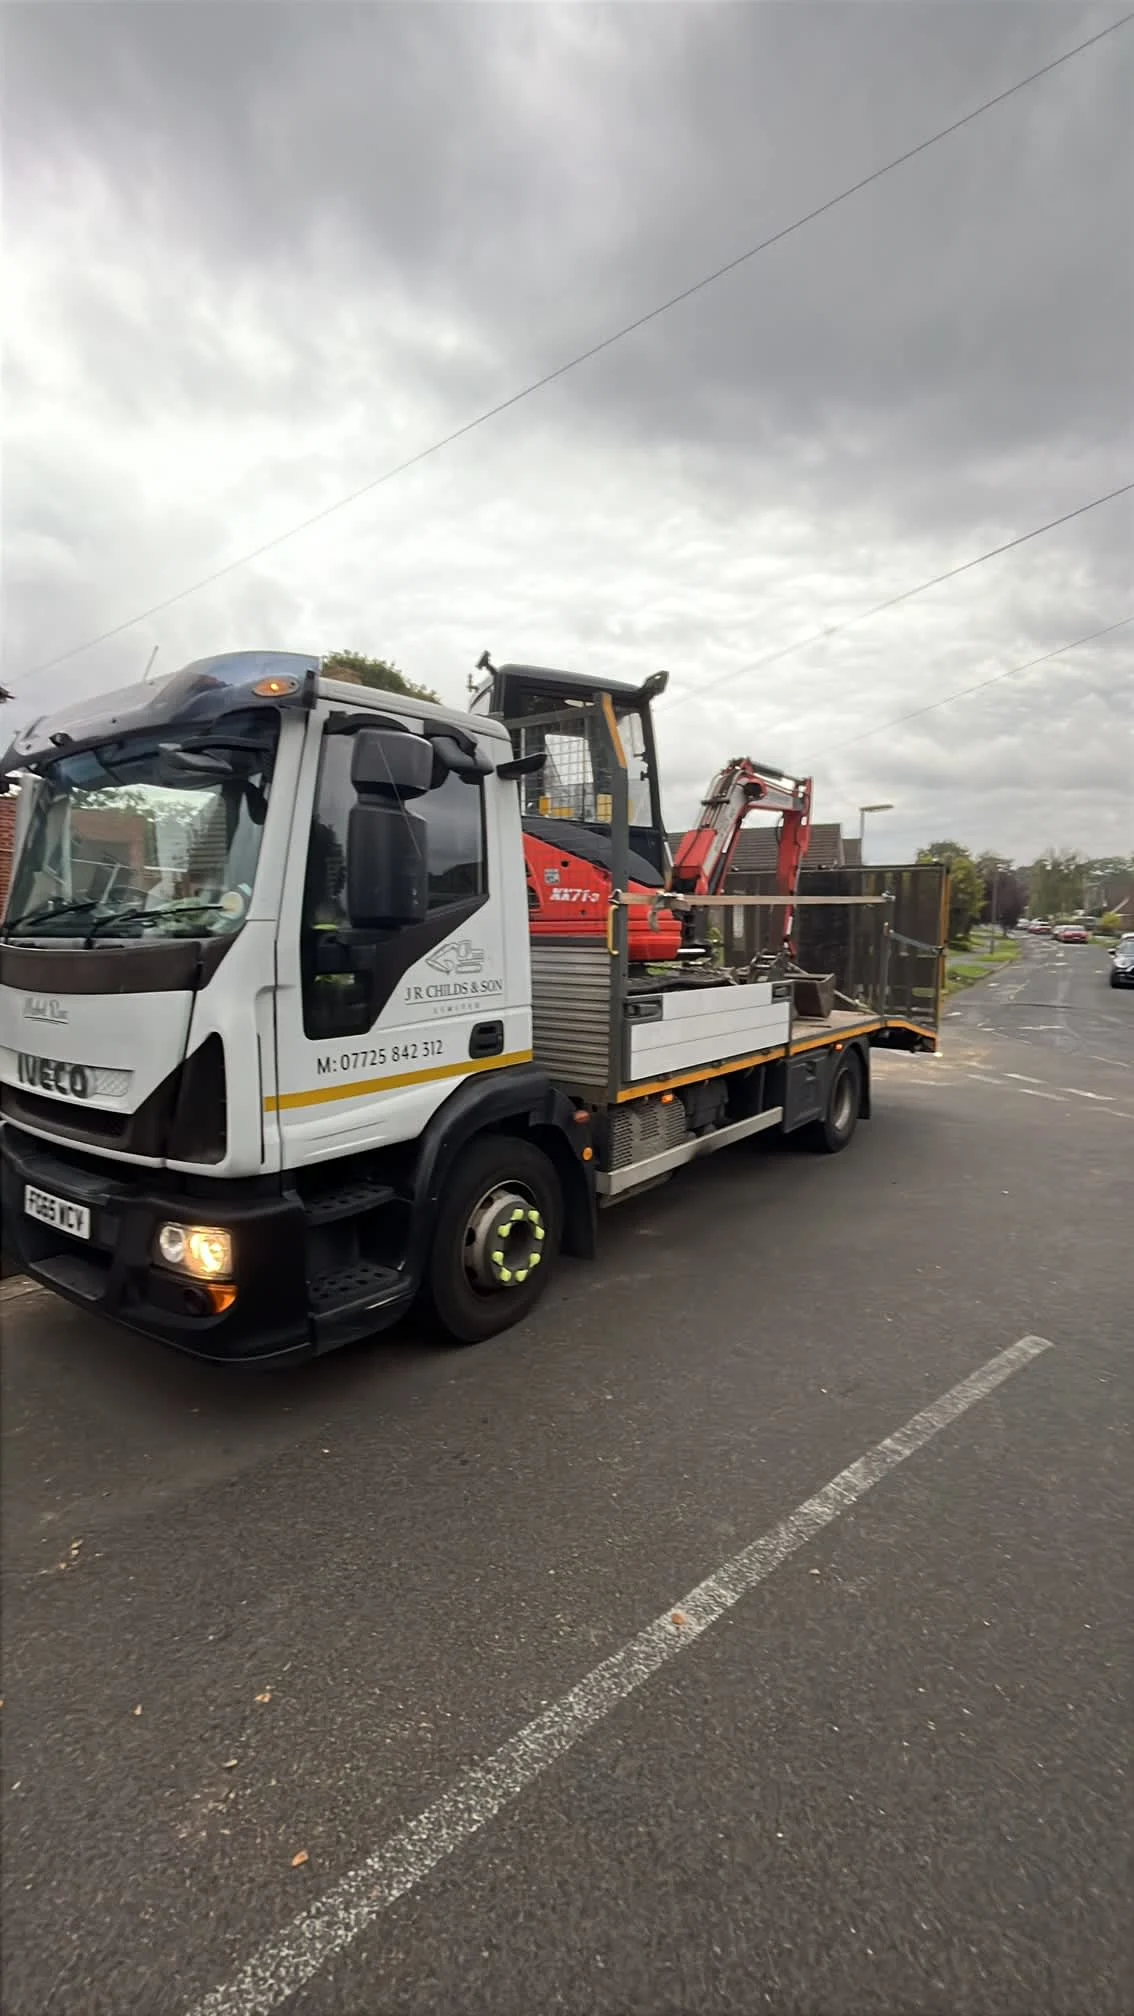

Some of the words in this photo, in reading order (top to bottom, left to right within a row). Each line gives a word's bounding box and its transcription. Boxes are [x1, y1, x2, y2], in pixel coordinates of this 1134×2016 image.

[414, 987, 423, 999] R
[426, 982, 469, 998] CHILDS
[471, 981, 479, 993] &
[480, 979, 503, 992] SON
[392, 1043, 418, 1062] 842
[422, 1039, 443, 1056] 312
[18, 1052, 89, 1099] IVECO
